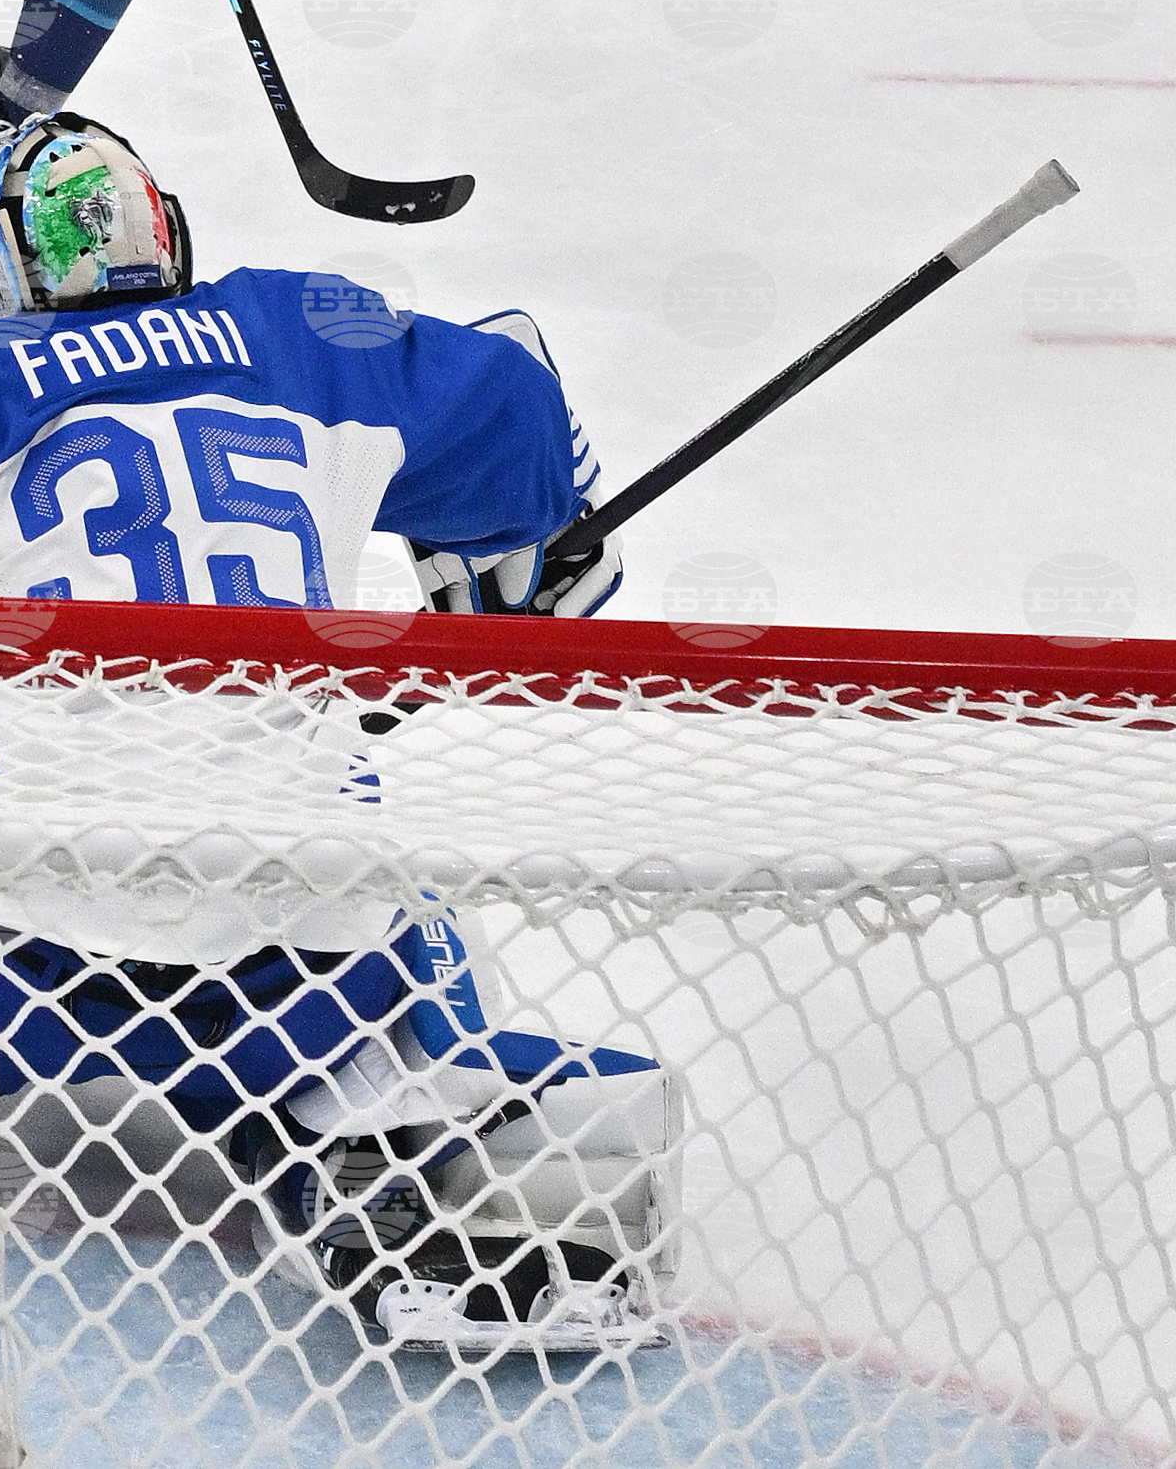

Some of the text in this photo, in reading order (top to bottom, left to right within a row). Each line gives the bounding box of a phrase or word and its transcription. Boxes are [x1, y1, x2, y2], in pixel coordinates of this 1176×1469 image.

[248, 39, 287, 111] FLYLITE
[10, 309, 252, 398] FADANI
[11, 408, 334, 610] 35
